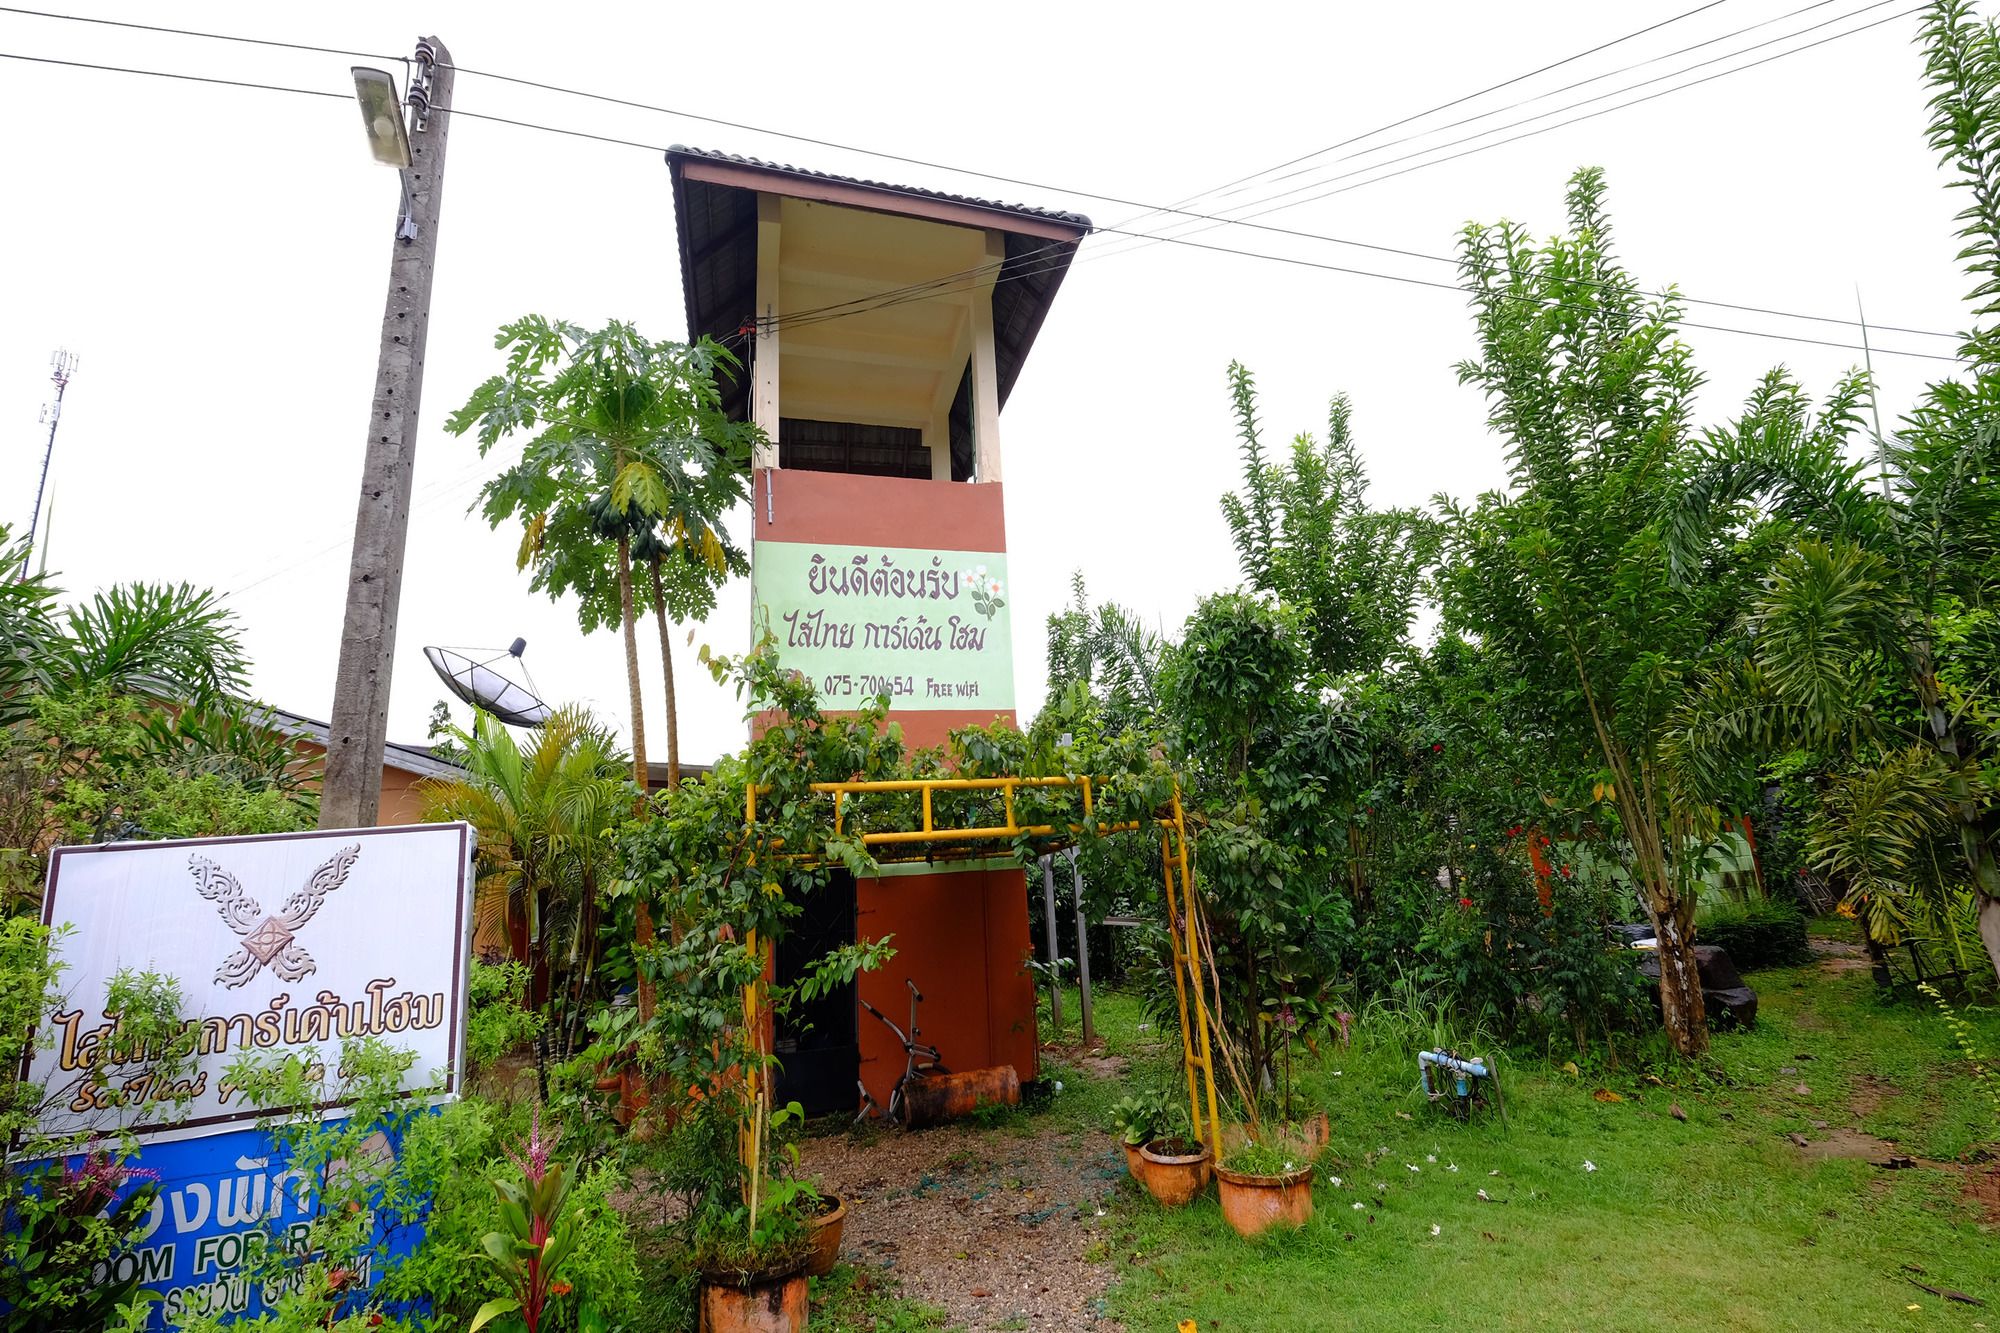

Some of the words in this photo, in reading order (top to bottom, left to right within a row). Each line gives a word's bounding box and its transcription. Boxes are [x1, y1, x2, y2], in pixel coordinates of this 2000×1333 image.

[808, 553, 960, 600] ยินดีต้อนรับ
[783, 608, 856, 650] ไสไทย
[863, 614, 943, 651] การ์เด้น
[947, 615, 987, 651] โฮม
[84, 1243, 176, 1290] OOM
